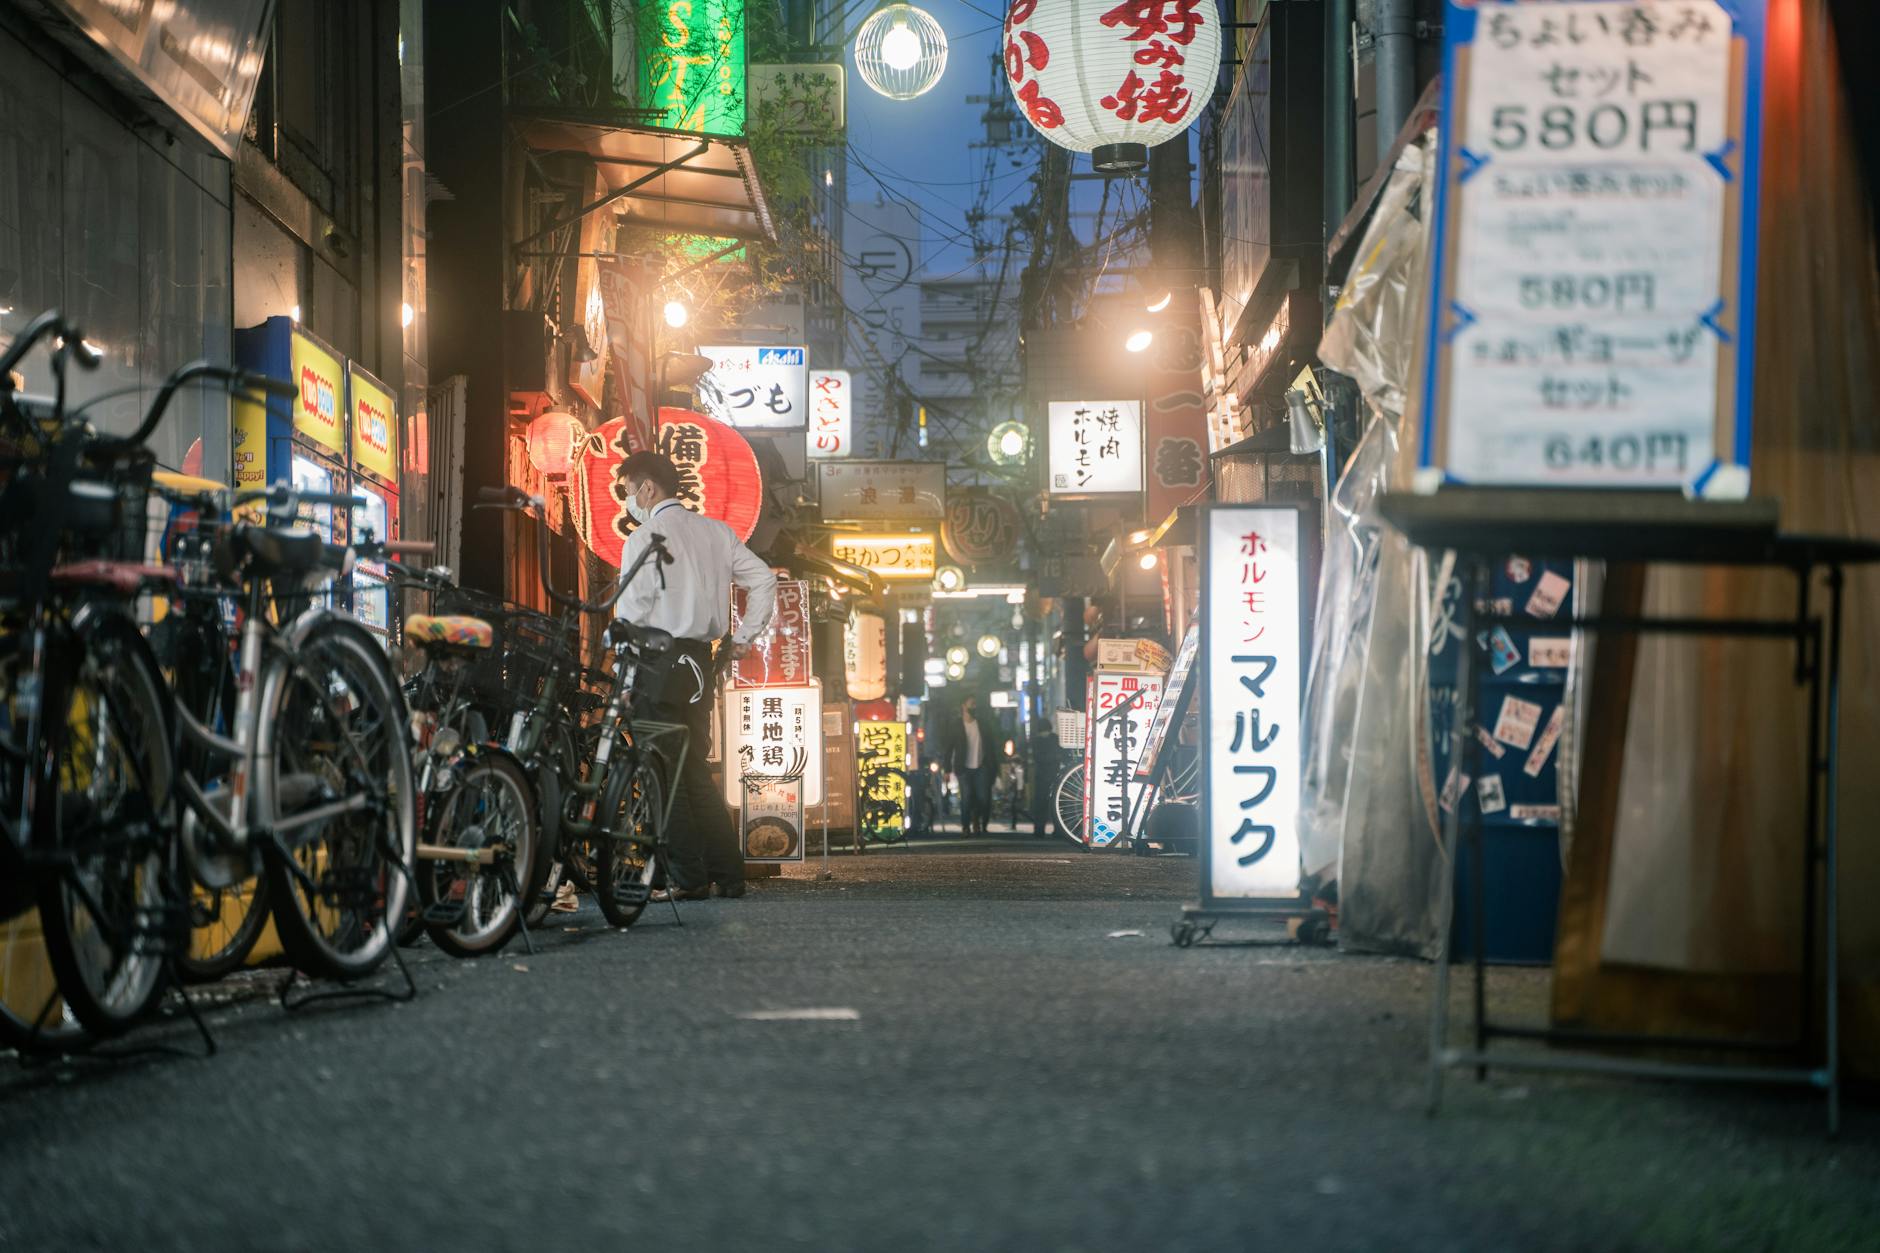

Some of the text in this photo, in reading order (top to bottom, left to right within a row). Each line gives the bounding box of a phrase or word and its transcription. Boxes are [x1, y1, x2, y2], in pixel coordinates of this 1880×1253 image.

[1490, 9, 1713, 48] ちょい呑み
[1542, 60, 1654, 97] セット
[1491, 99, 1698, 151] 580円
[1519, 272, 1656, 311] 580円
[761, 349, 800, 365] Asahi
[1074, 403, 1093, 487] ホルモン
[1096, 403, 1121, 459] 焼肉
[1545, 433, 1689, 474] 640円
[836, 546, 900, 567] 串かつ
[1241, 531, 1266, 642] ホルモン
[1100, 678, 1139, 691] 一皿
[762, 697, 783, 766] 黒地鶏
[1229, 654, 1279, 867] マルフク
[752, 803, 795, 811] はじめました
[780, 811, 798, 819] 700円
